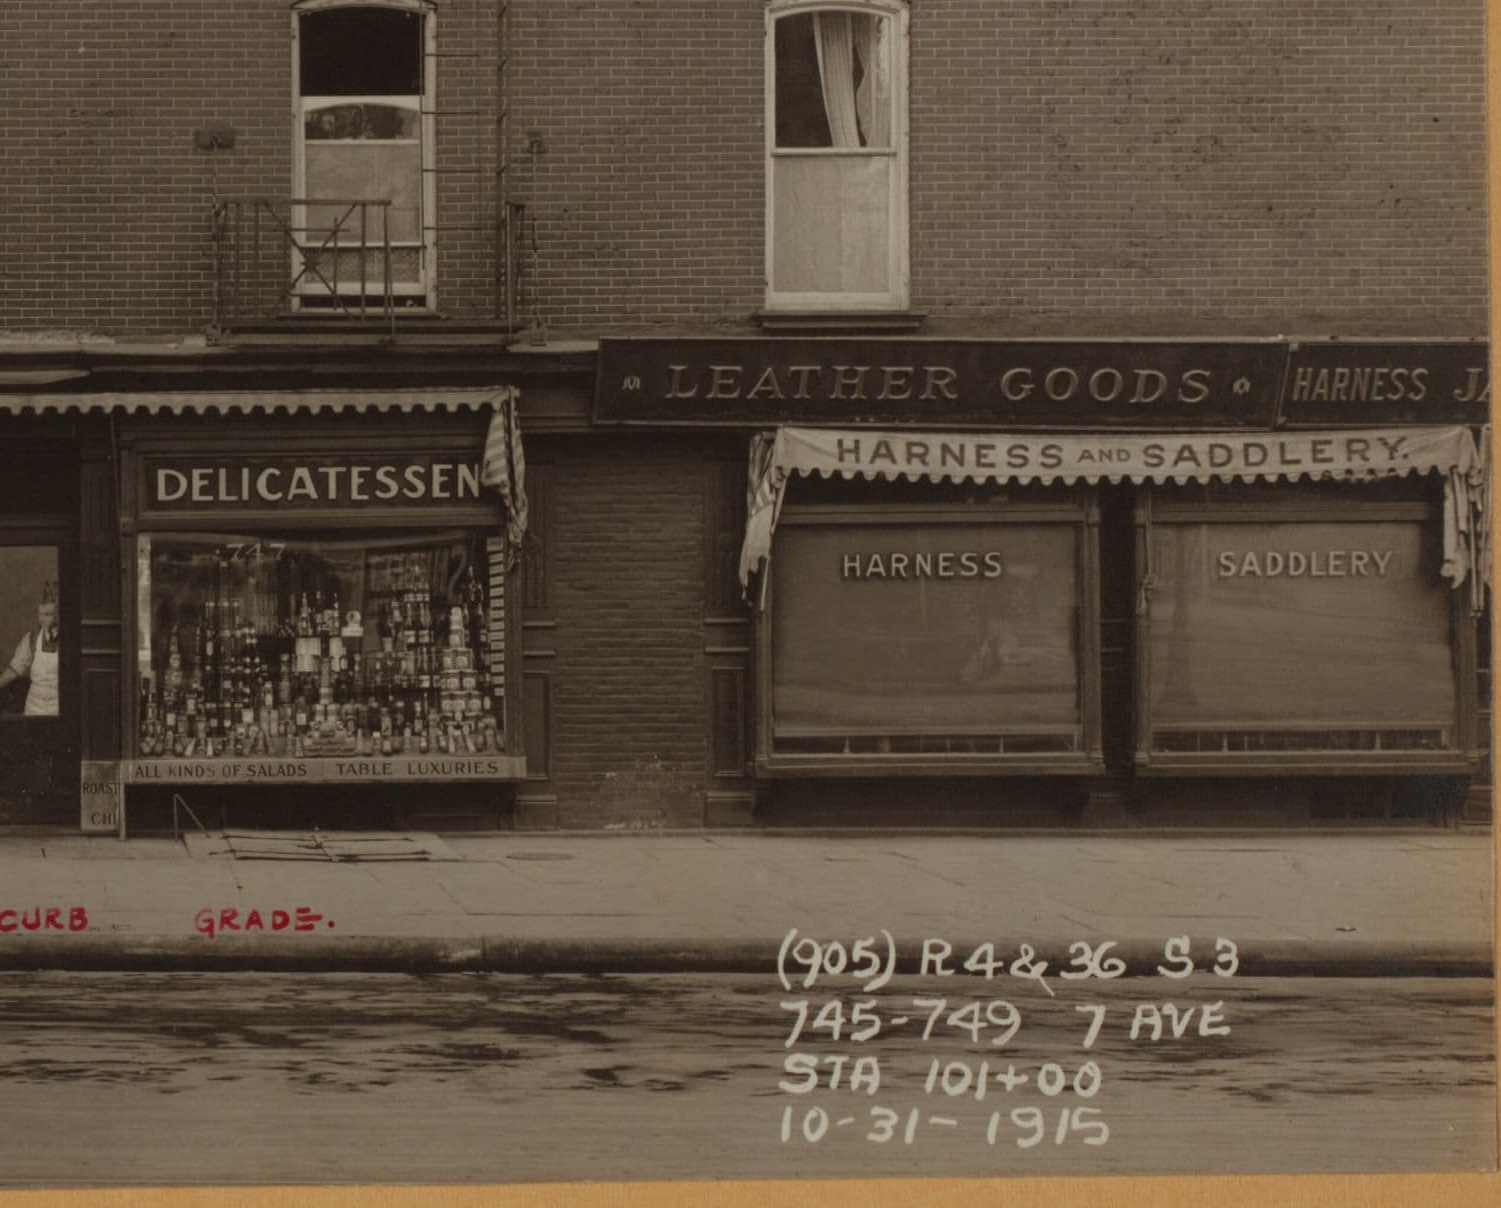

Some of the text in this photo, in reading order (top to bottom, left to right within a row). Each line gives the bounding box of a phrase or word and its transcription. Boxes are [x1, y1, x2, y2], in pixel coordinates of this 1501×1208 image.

[664, 364, 1211, 403] LEATHER GOODS
[1293, 367, 1429, 402] HARNESS
[835, 437, 1065, 469] HARNESS
[1076, 447, 1132, 464] AND
[156, 463, 481, 503] DELICATESSEN
[225, 543, 288, 562] 747
[842, 551, 1003, 579] HARNESS
[1218, 550, 1393, 578] SADDLERY
[134, 763, 308, 779] ALL KINDS OF SALADS
[335, 759, 499, 777] TABLE LUXURIES
